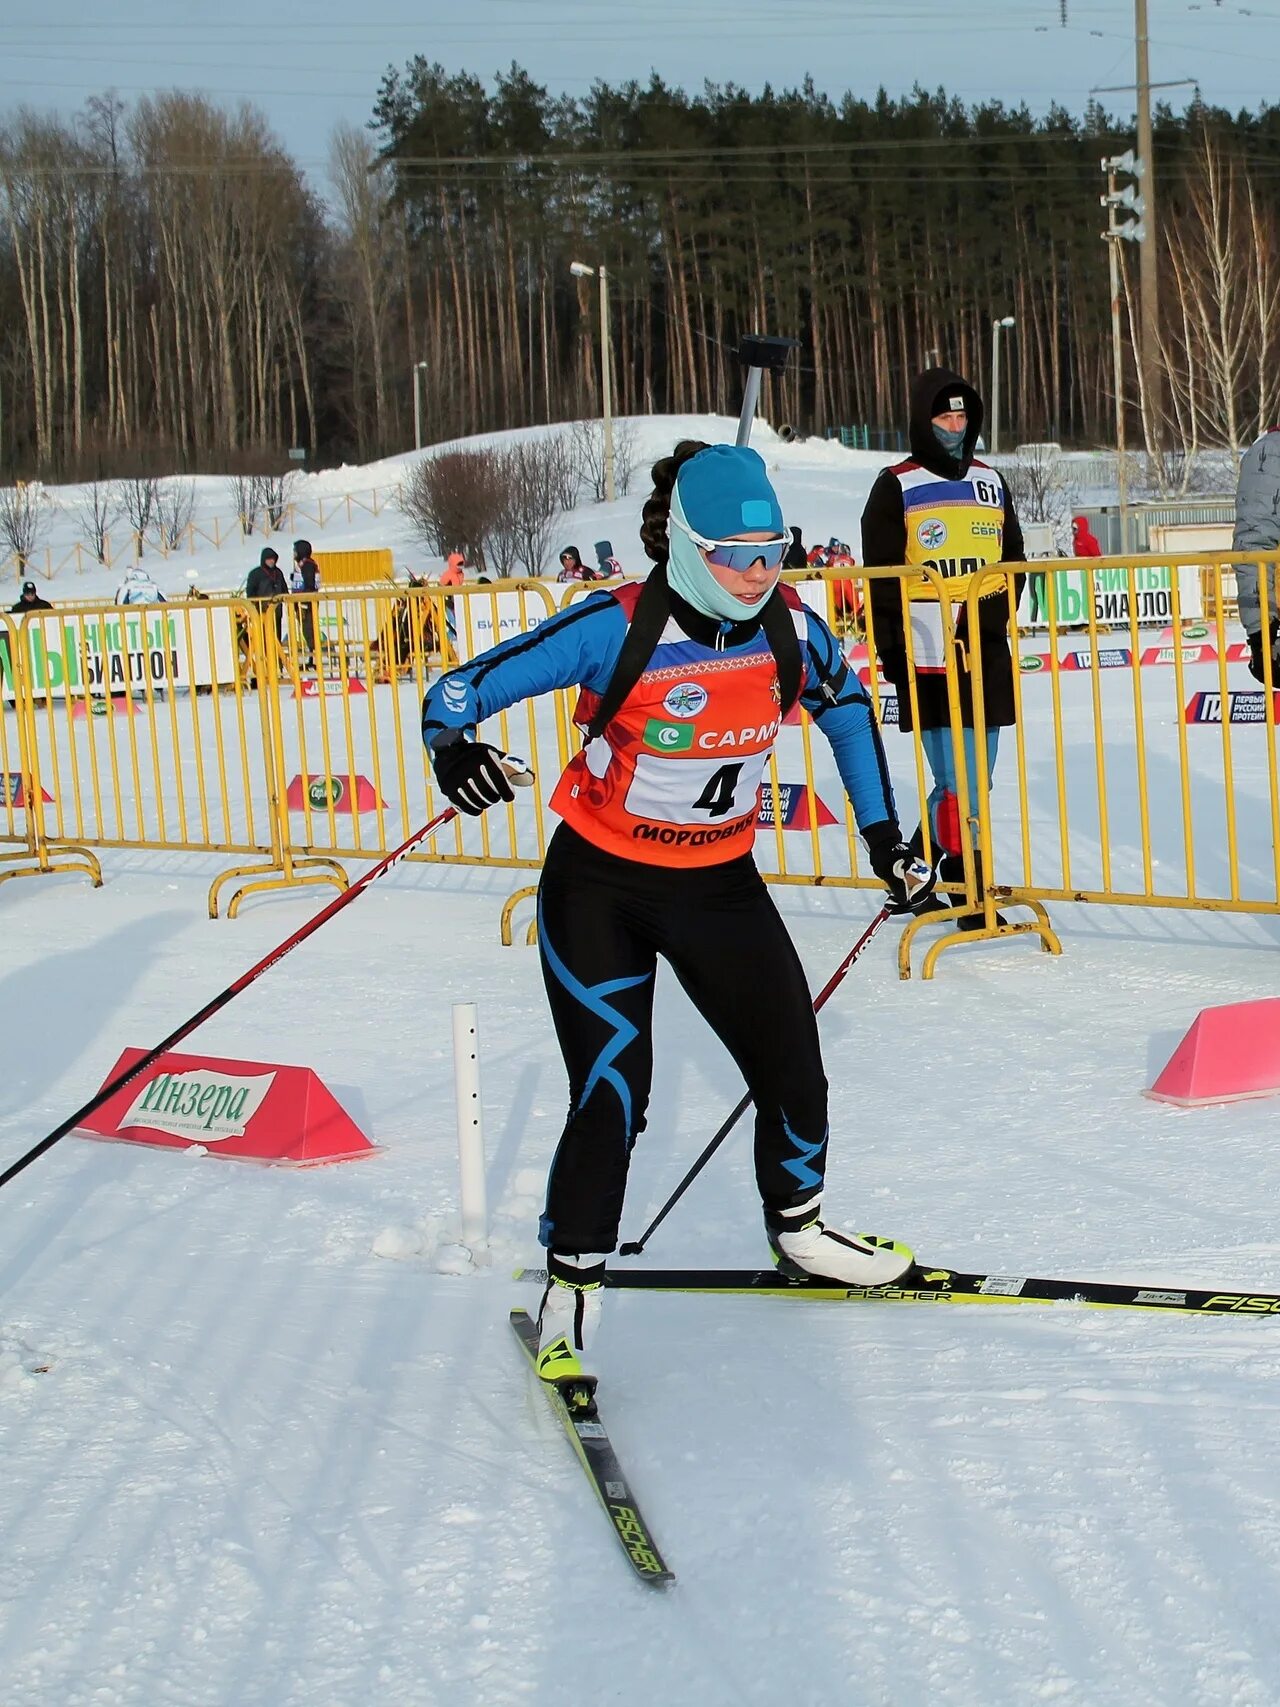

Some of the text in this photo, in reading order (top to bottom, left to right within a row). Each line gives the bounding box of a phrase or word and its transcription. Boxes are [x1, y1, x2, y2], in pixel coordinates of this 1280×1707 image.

[976, 481, 998, 504] 61
[699, 713, 781, 750] САРМ
[138, 1074, 251, 1129] Инзера
[845, 1288, 952, 1302] FISCHER
[609, 1504, 662, 1573] FISCHER
